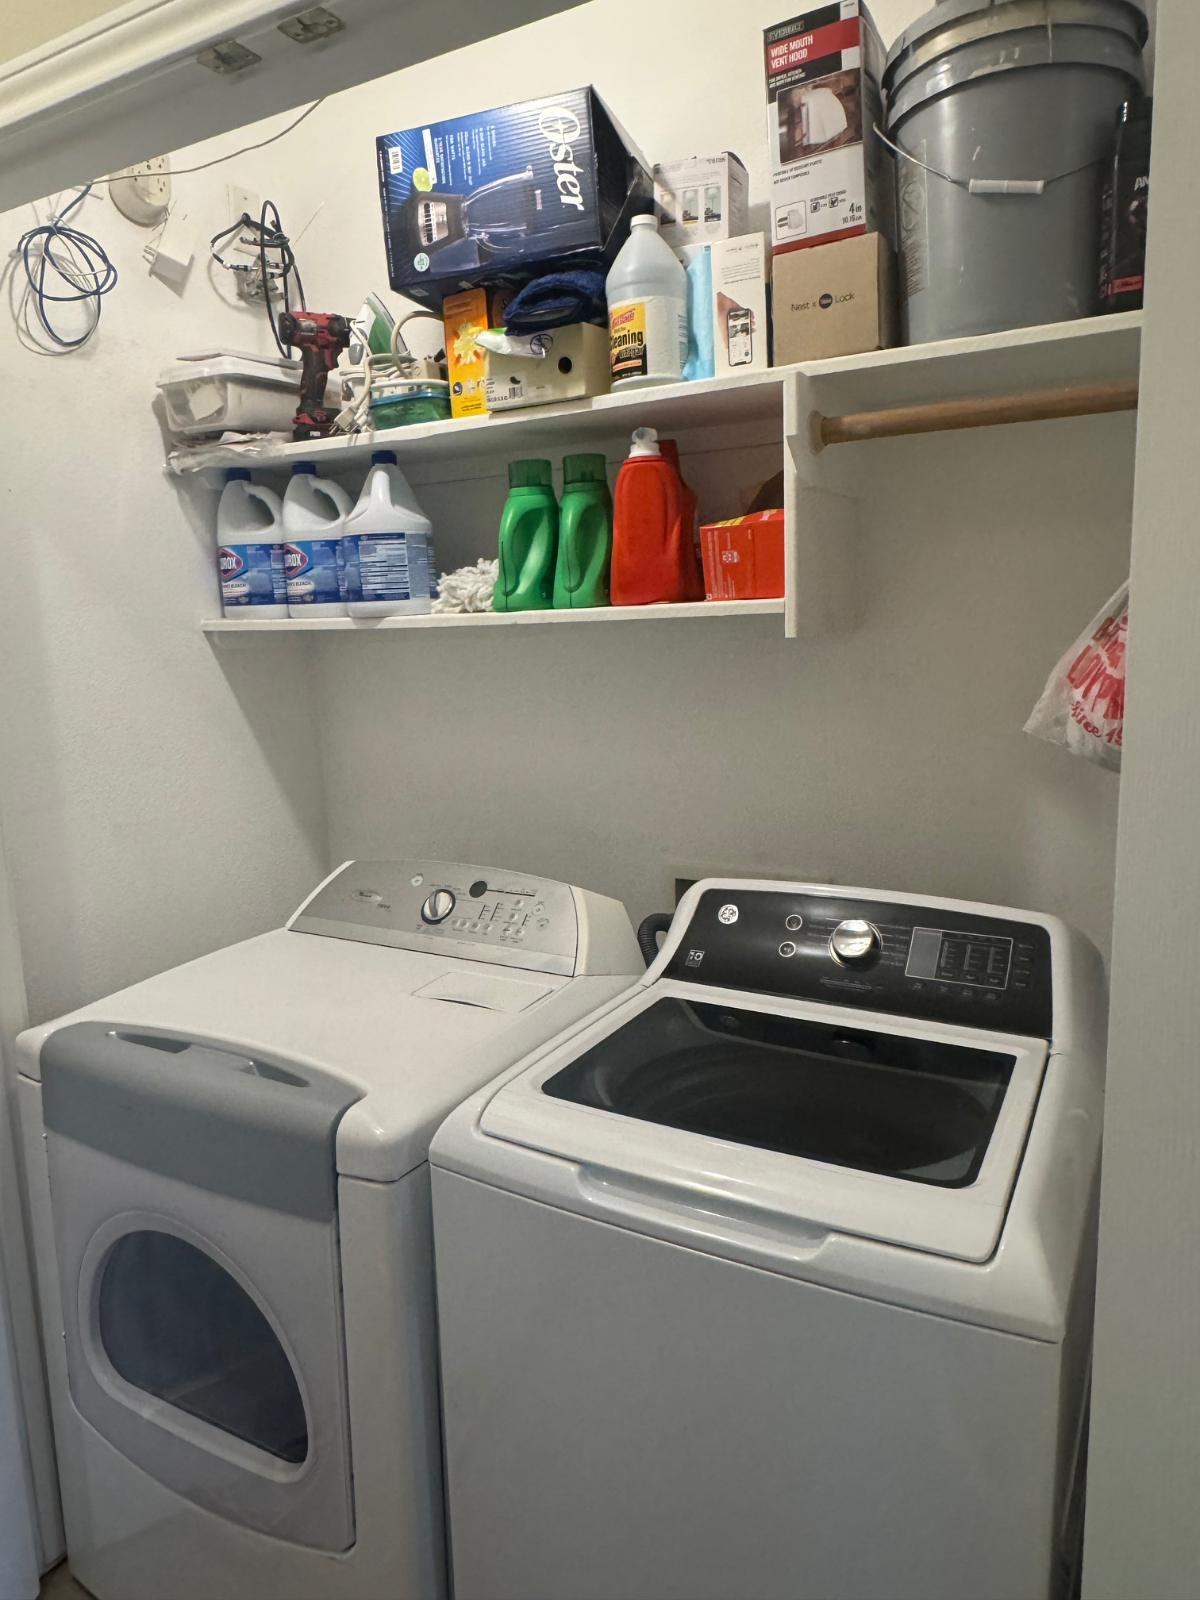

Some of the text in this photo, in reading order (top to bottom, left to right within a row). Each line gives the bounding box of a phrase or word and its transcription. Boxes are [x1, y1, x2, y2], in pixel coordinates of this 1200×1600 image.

[771, 34, 813, 58] WIDE MOUTH
[771, 48, 808, 69] VENT HOOD
[539, 106, 585, 211] Oster
[849, 202, 855, 214] 4
[835, 292, 855, 304] Lock
[790, 302, 810, 312] Nest
